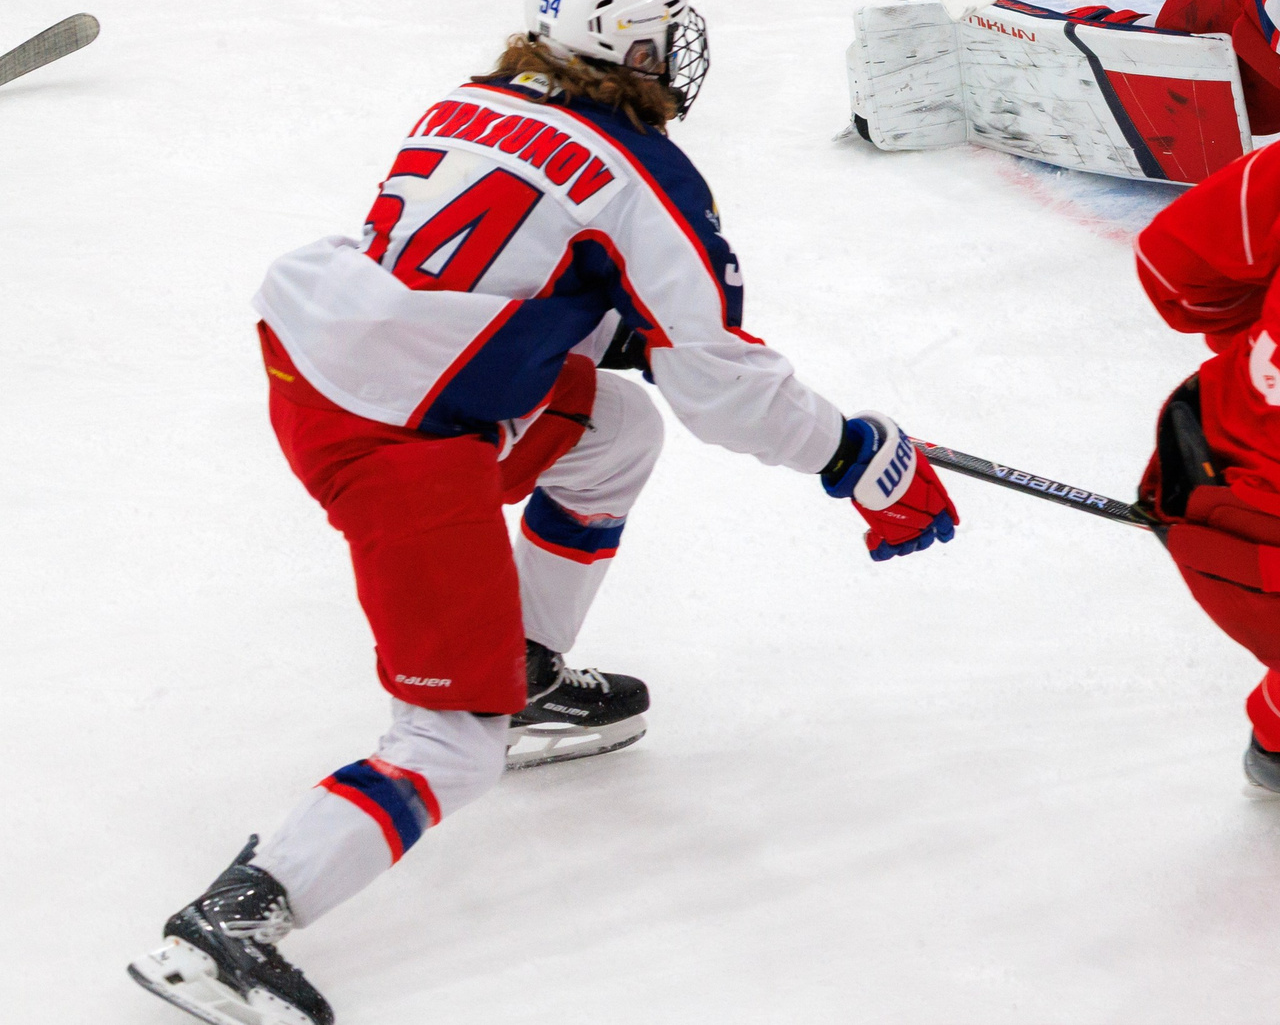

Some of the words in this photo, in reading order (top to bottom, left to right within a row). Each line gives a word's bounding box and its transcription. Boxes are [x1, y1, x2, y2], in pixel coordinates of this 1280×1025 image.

[1008, 469, 1109, 509] BAUER
[395, 674, 452, 688] BAUER
[542, 702, 590, 717] BAUER
